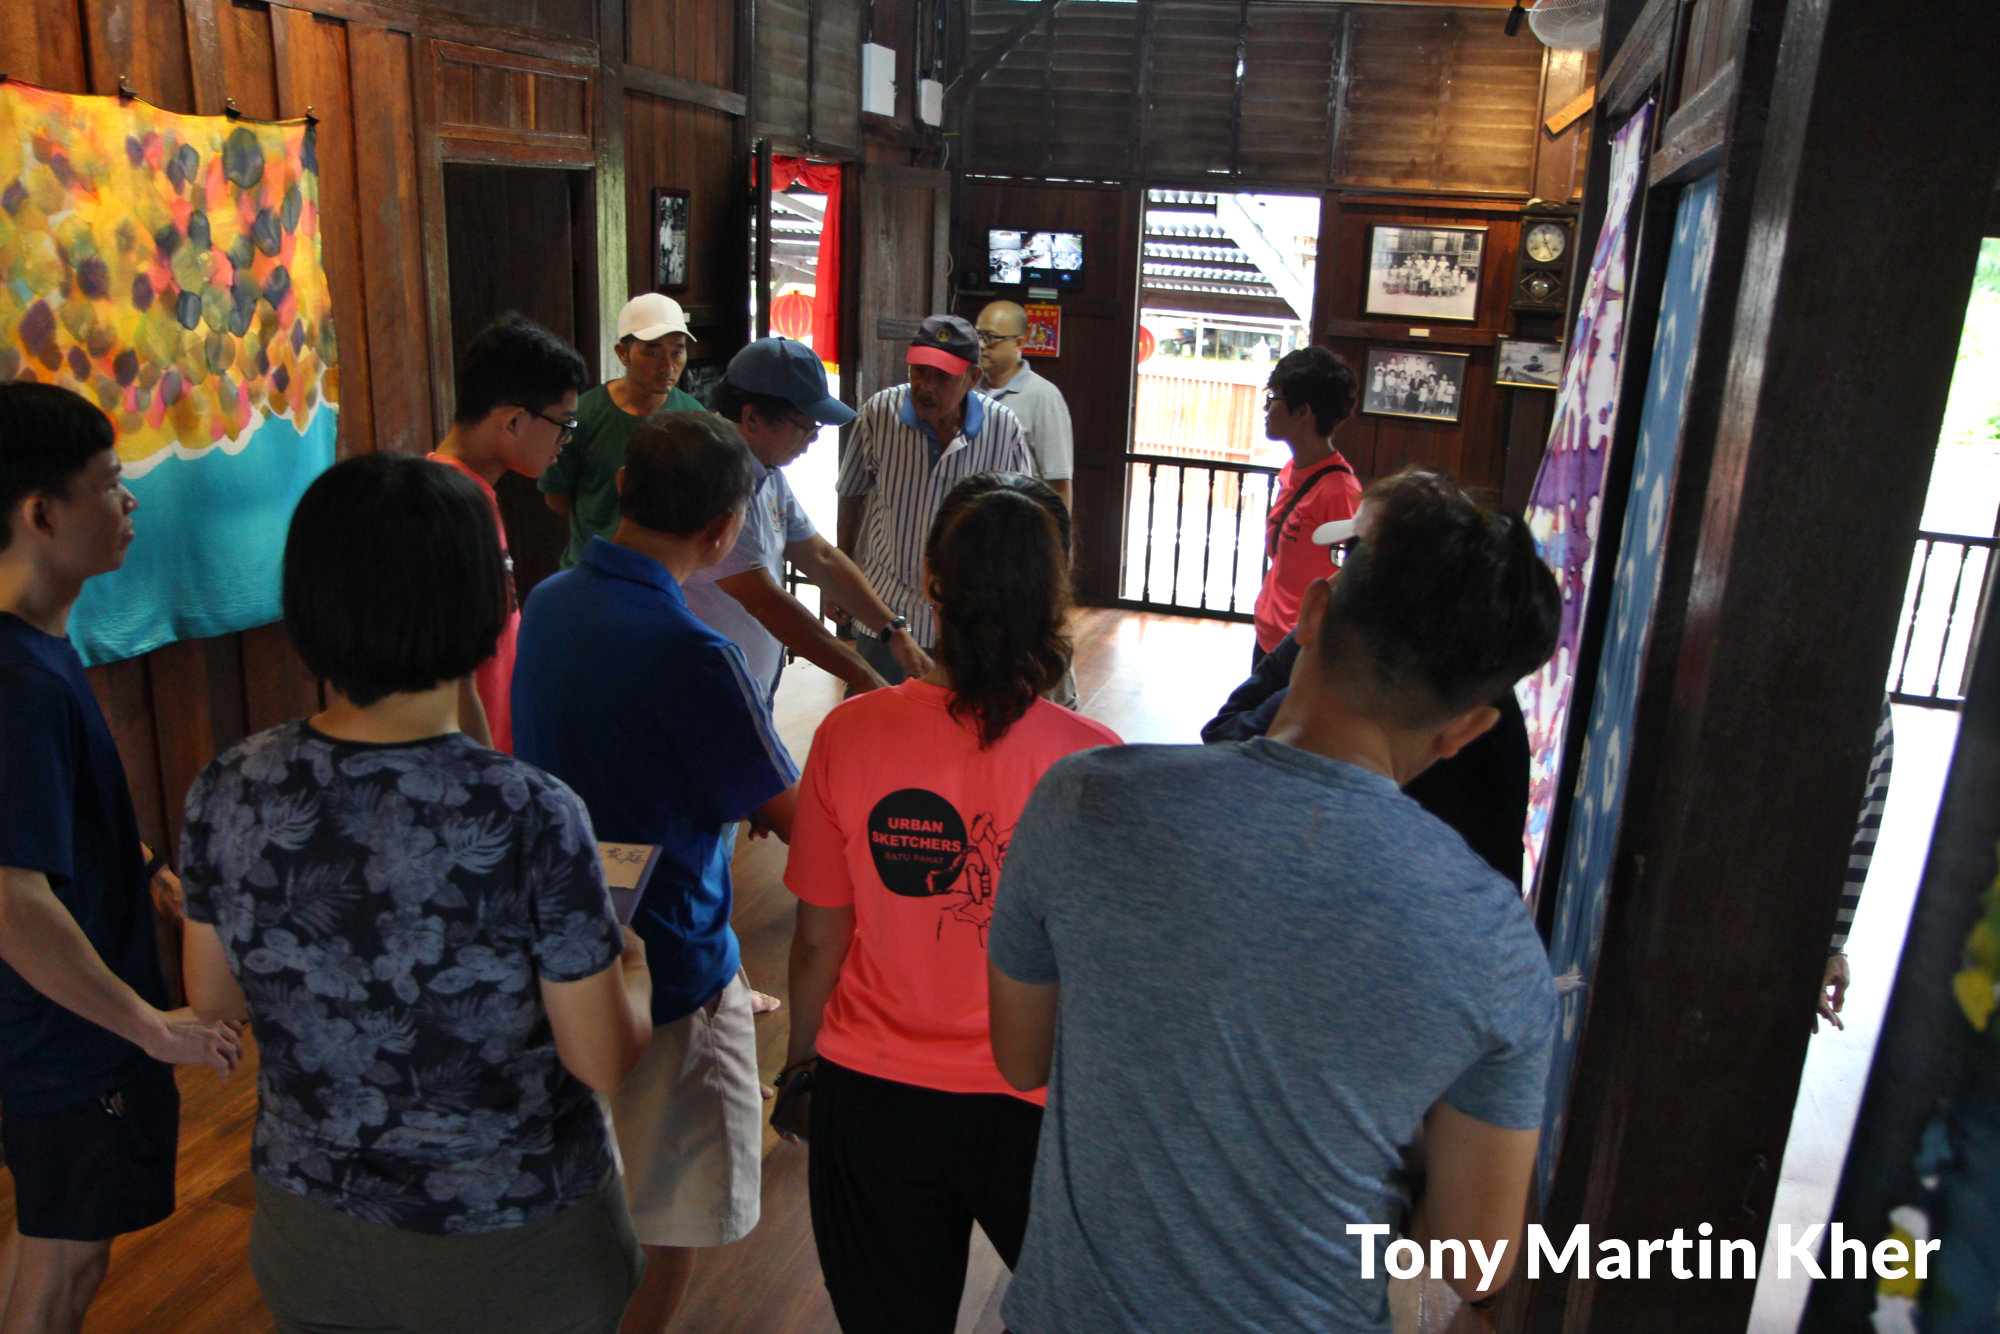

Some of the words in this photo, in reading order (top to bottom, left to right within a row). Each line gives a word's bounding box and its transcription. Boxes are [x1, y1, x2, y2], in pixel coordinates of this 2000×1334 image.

[888, 817, 943, 832] URBAN
[872, 832, 962, 852] SKETCHERS
[884, 853, 911, 862] BATU
[913, 854, 943, 864] PAHAT
